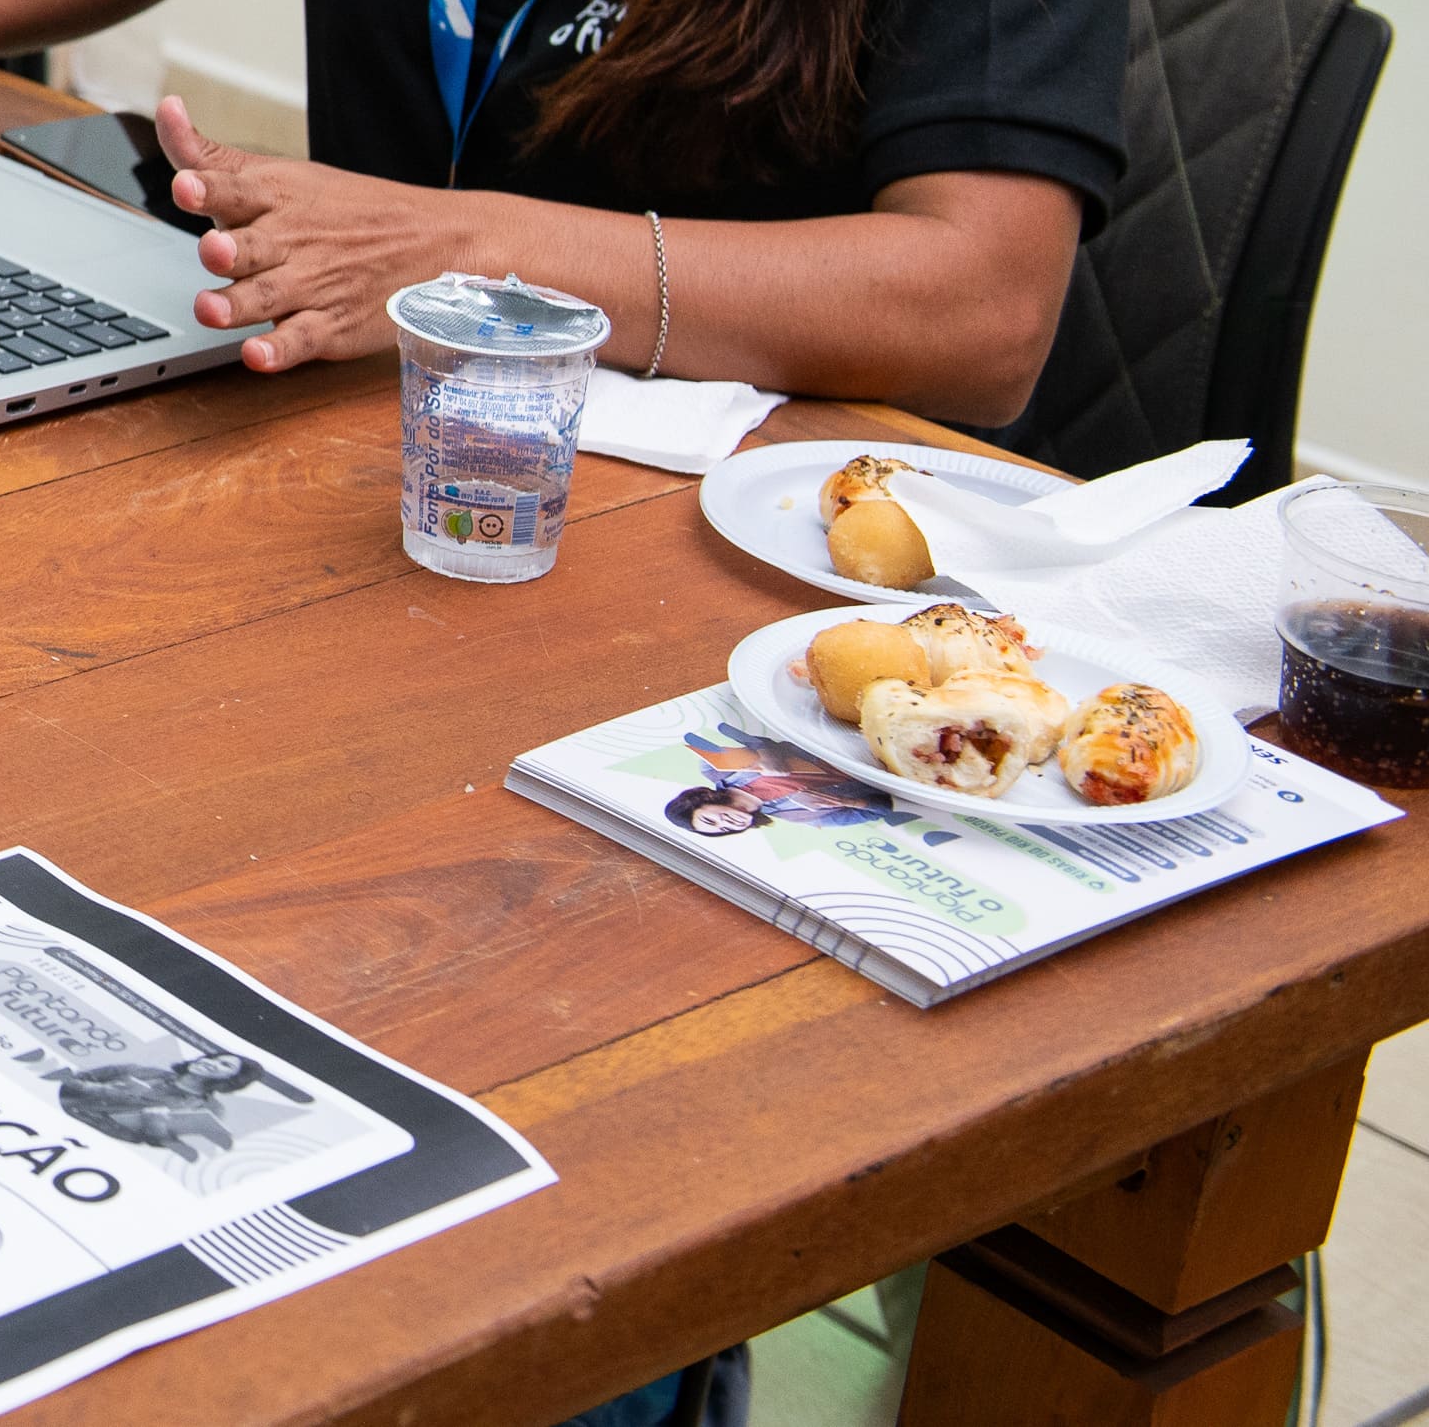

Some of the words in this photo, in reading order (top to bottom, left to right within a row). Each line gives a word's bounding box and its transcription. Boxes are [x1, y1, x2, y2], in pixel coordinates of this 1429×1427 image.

[425, 374, 442, 410] Sol
[427, 410, 441, 442] do
[424, 443, 441, 480] Pôr
[423, 482, 441, 539] Fonte
[966, 815, 1006, 840] PARDO
[1005, 831, 1032, 851] RIO
[1029, 843, 1050, 859] DO
[1048, 852, 1088, 880] RIBAS
[833, 838, 987, 926] Plantando
[865, 835, 978, 910] futuro
[973, 899, 1006, 914] o
